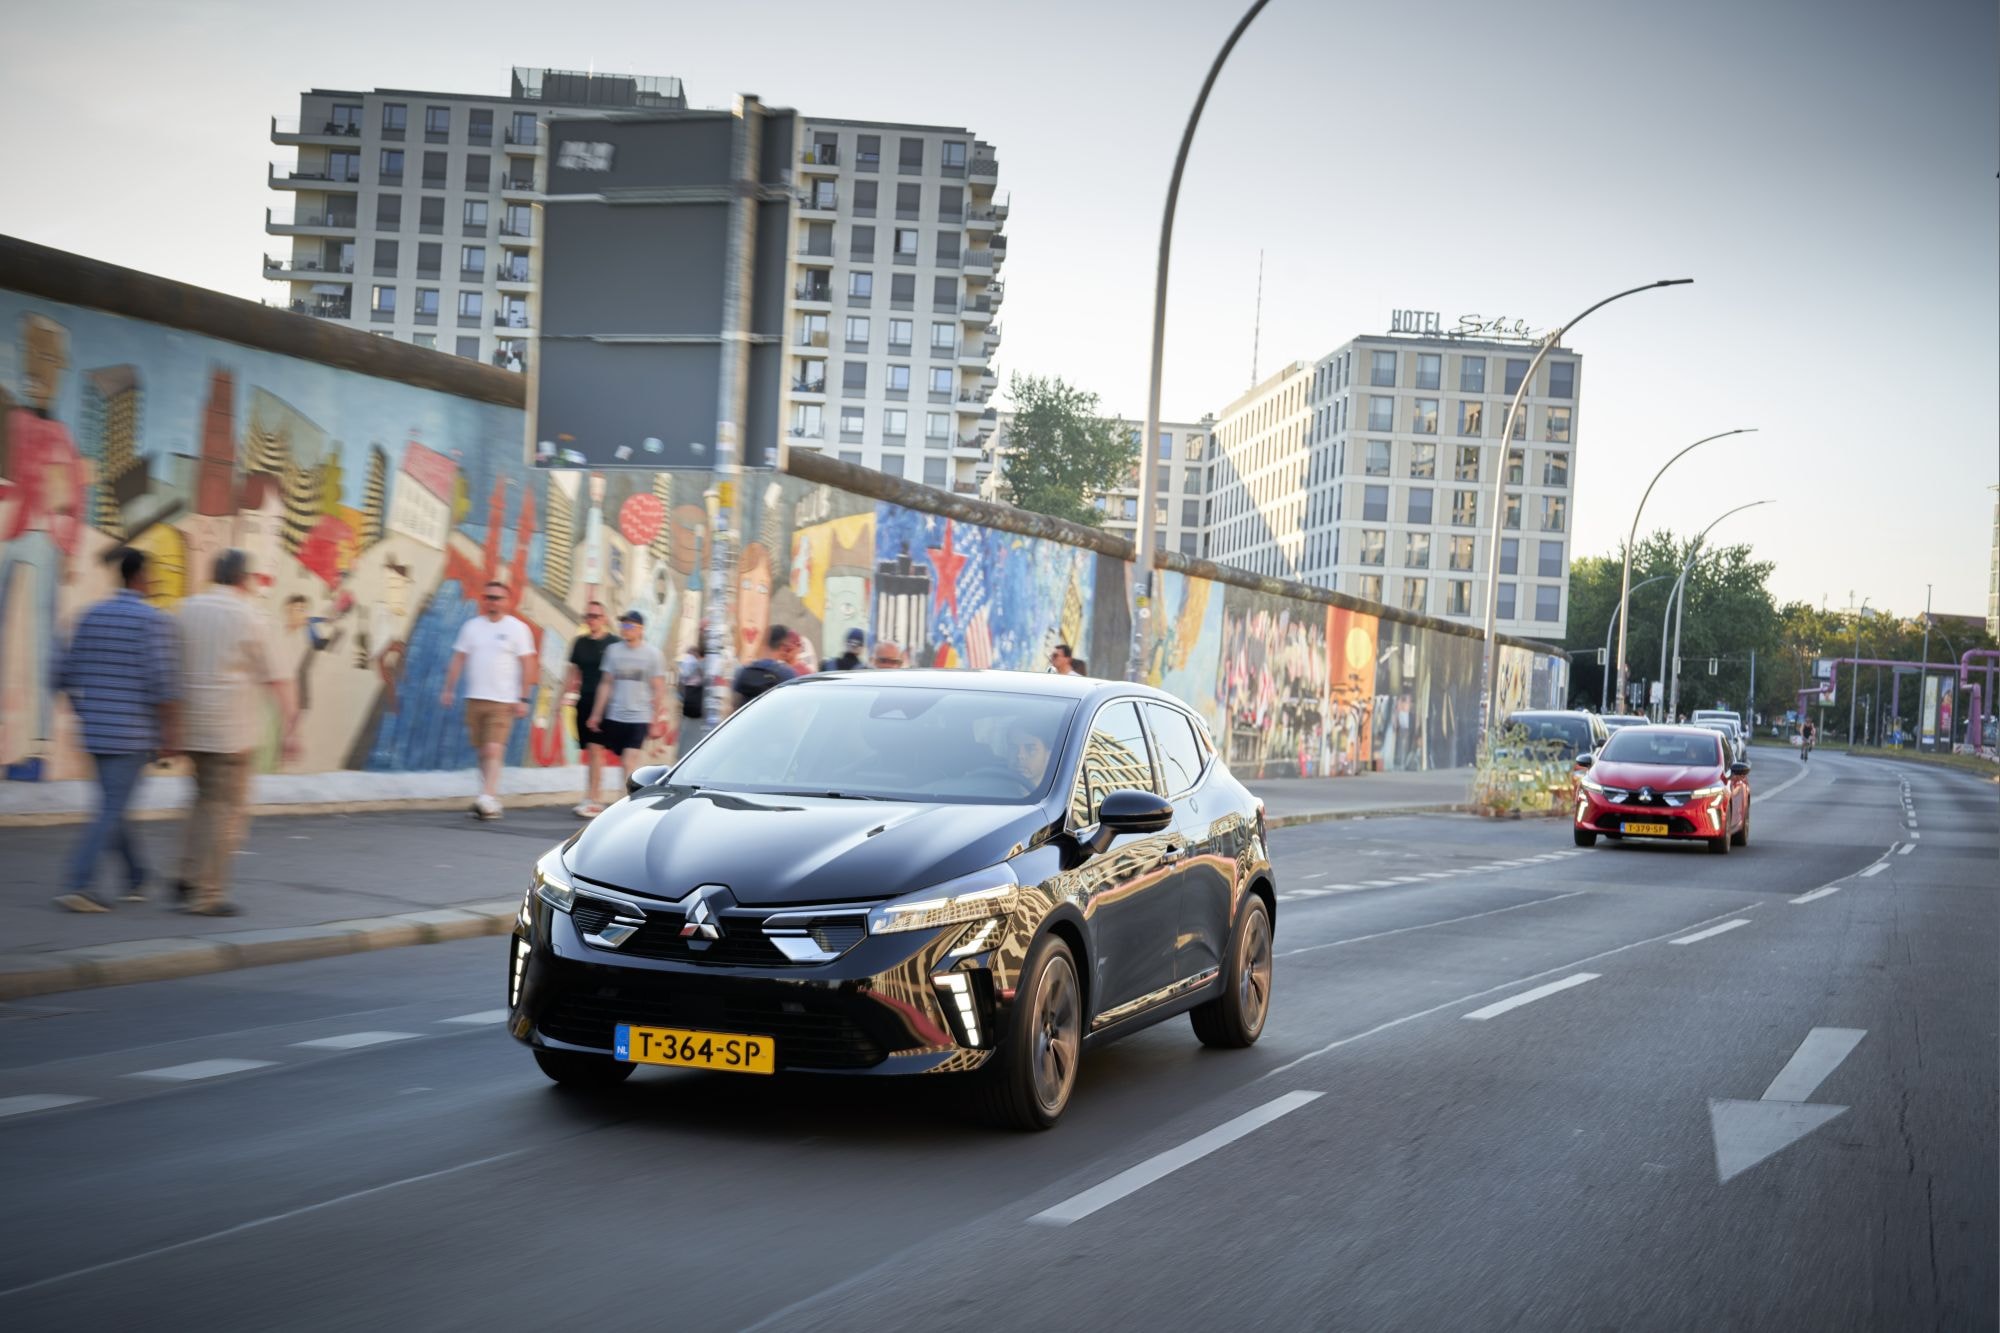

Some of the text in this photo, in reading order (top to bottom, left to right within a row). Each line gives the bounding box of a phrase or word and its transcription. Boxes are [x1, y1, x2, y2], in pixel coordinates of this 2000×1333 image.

[1391, 309, 1443, 335] HOTEL
[1628, 824, 1664, 833] T-379-SP
[617, 1046, 628, 1054] NL
[639, 1032, 761, 1066] T-364-SP
